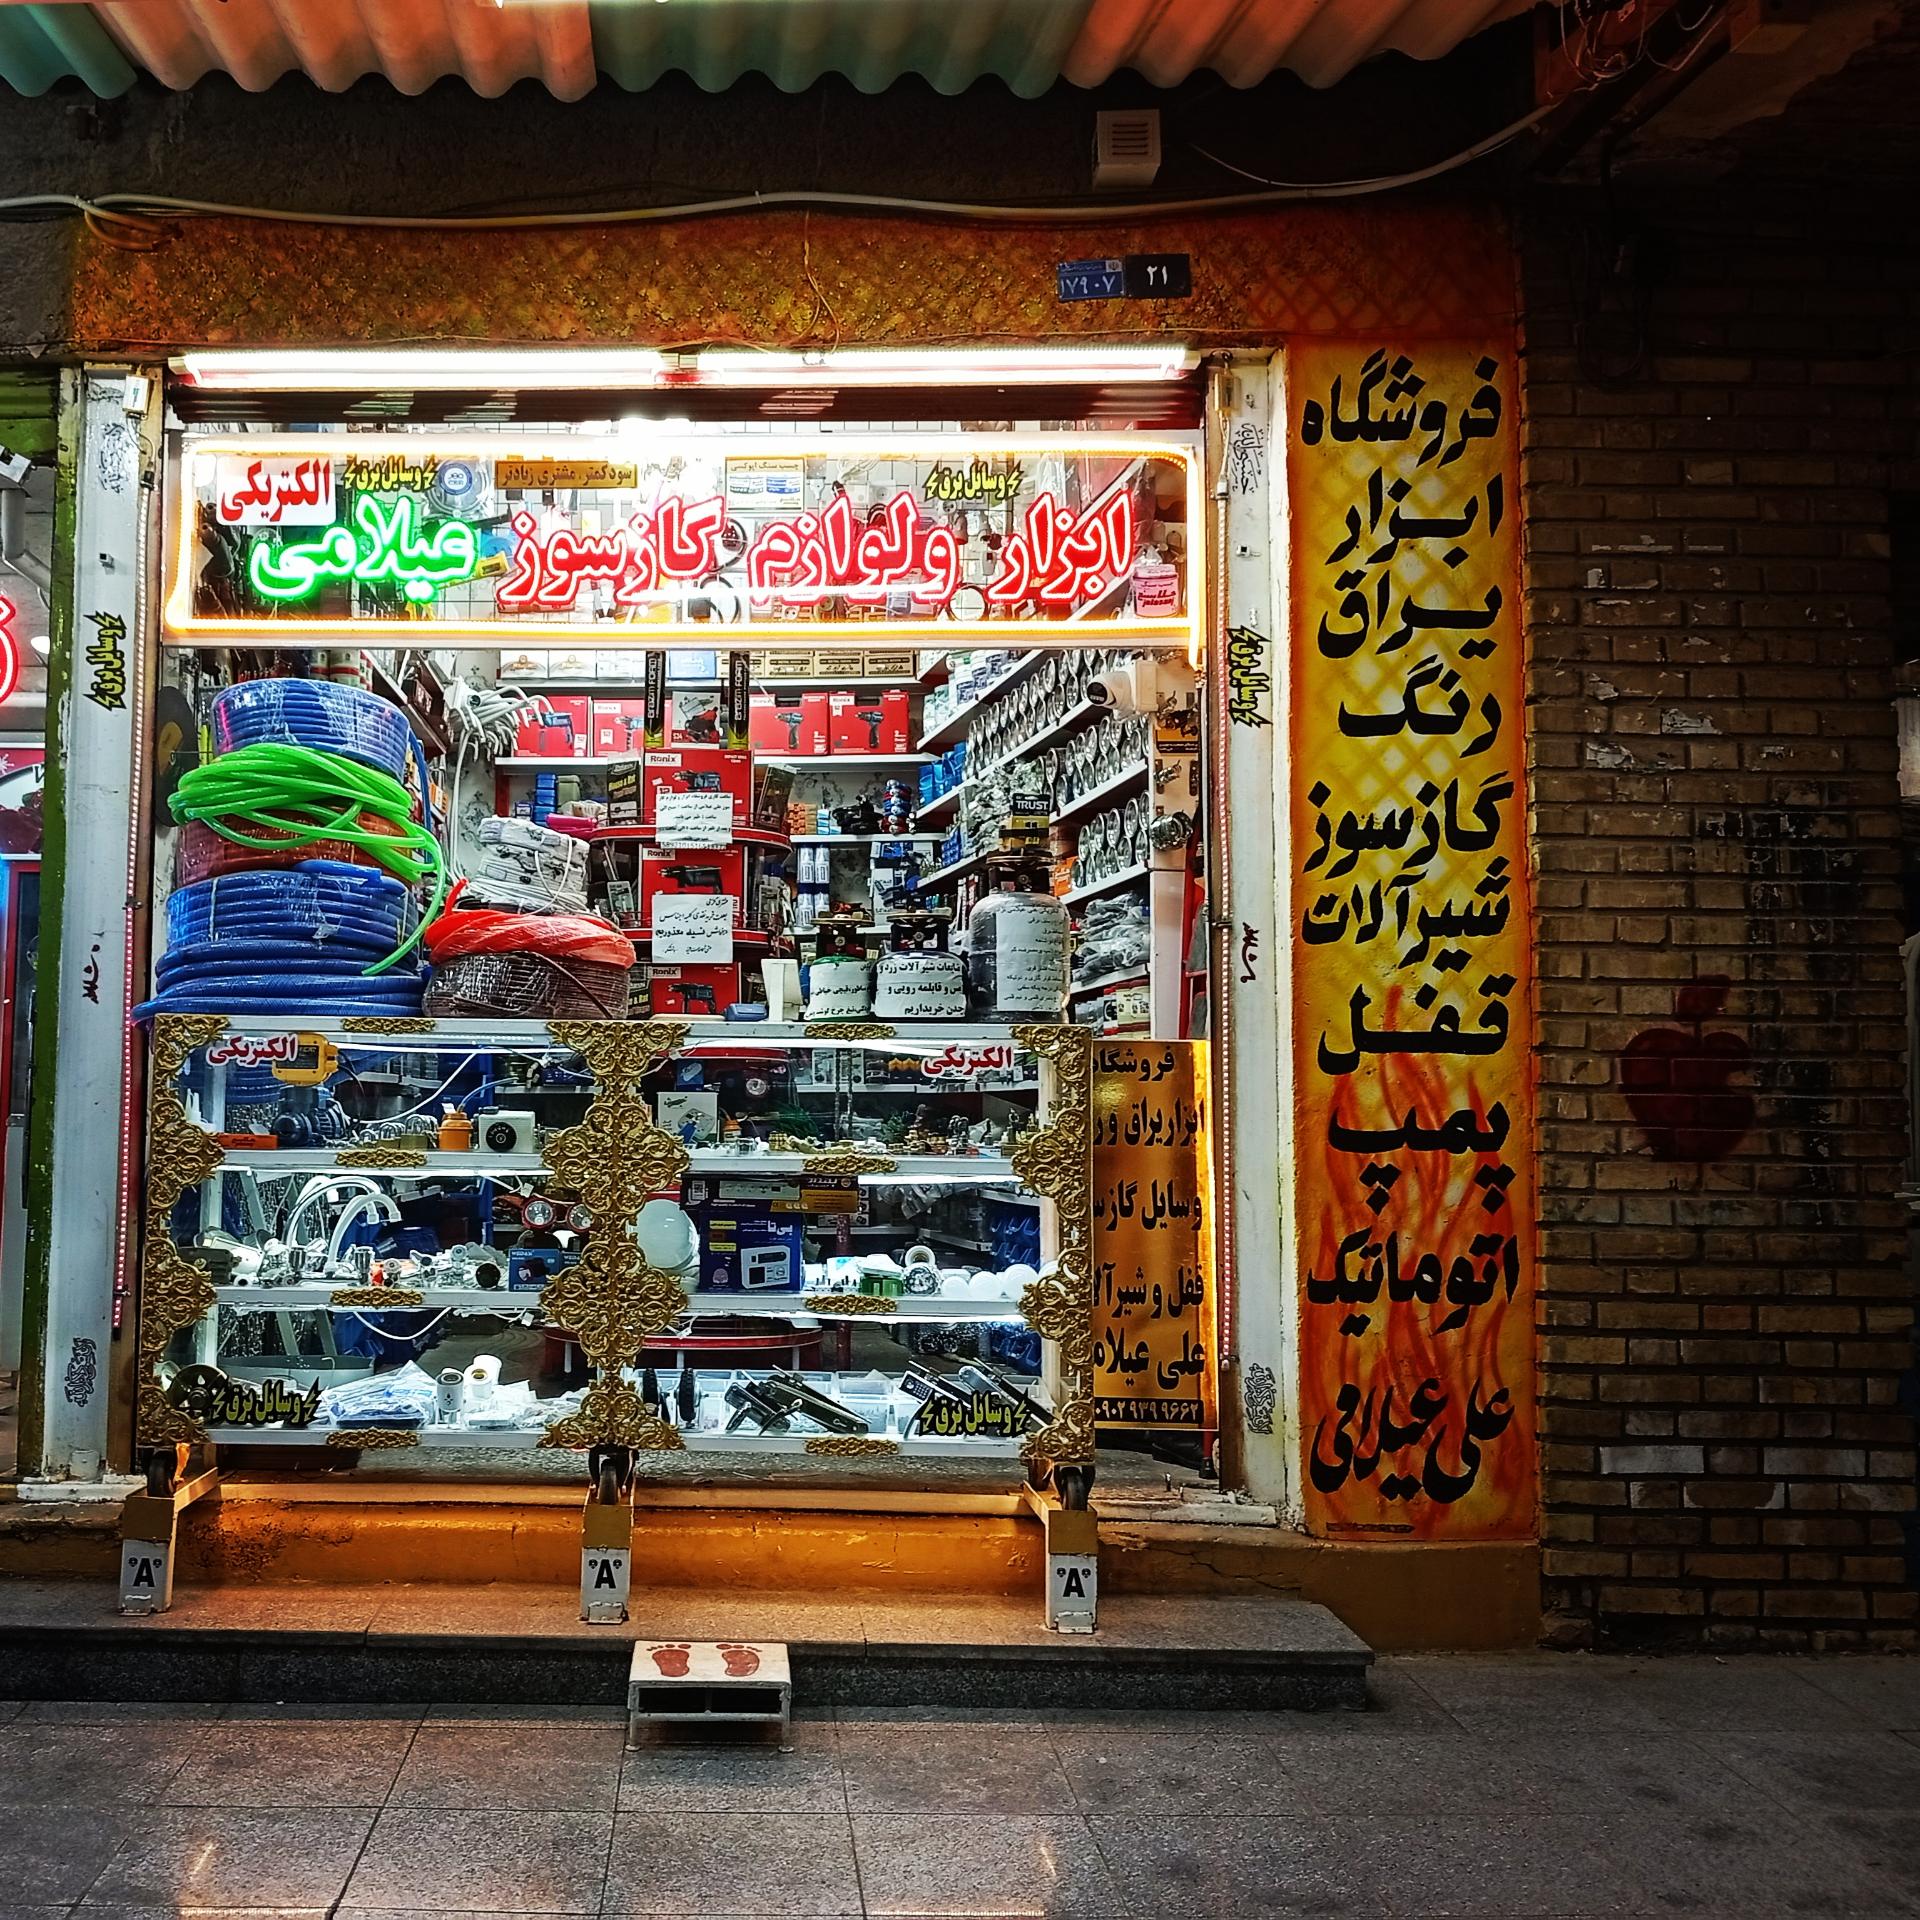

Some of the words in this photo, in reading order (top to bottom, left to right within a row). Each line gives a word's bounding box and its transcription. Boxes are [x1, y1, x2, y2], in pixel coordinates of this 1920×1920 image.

[1146, 265, 1168, 286] ۲۱
[1301, 348, 1502, 469] فروشگاه
[221, 460, 331, 523] الکتریکی
[356, 460, 382, 491] برق
[380, 454, 422, 491] وسایل
[538, 465, 576, 486] مشتری
[609, 466, 632, 486] سود
[938, 466, 965, 500] برق
[964, 461, 1007, 500] وسایل
[1325, 466, 1504, 569] ابزار
[748, 490, 919, 606] لوازم
[913, 521, 960, 605] و
[985, 489, 1136, 603] ابزار
[1318, 569, 1503, 660] یراق
[85, 622, 127, 670] وسایل
[1229, 637, 1263, 673] برق
[90, 668, 127, 703] برق
[1229, 671, 1271, 718] وسایل
[1338, 654, 1502, 759] رنگ
[650, 755, 677, 763] Ronix
[1016, 800, 1049, 810] TRUST
[904, 1002, 945, 1016] خریداریم
[1317, 973, 1518, 1075] قفل
[209, 1036, 297, 1065] الکتریکی
[924, 1044, 1013, 1075] الکتریکی
[1106, 1112, 1118, 1147] و
[1124, 1096, 1163, 1148] یراق
[1164, 1096, 1205, 1148] ابزار
[1328, 1101, 1518, 1216] پمپ
[1141, 1178, 1204, 1232] وسایل
[1150, 1282, 1163, 1320] و
[1167, 1263, 1205, 1319] قفل
[1307, 1225, 1521, 1338] اتوماتیک
[1157, 1329, 1206, 1391] علی
[226, 1385, 256, 1425] برق
[255, 1380, 302, 1424] وسایل
[935, 1397, 965, 1435] برق
[964, 1392, 1014, 1436] وسایل
[1309, 1377, 1450, 1502] عیلامی
[1421, 1376, 1516, 1504] علی
[132, 1557, 156, 1589] A
[594, 1559, 617, 1590] A
[1063, 1567, 1086, 1598] A
